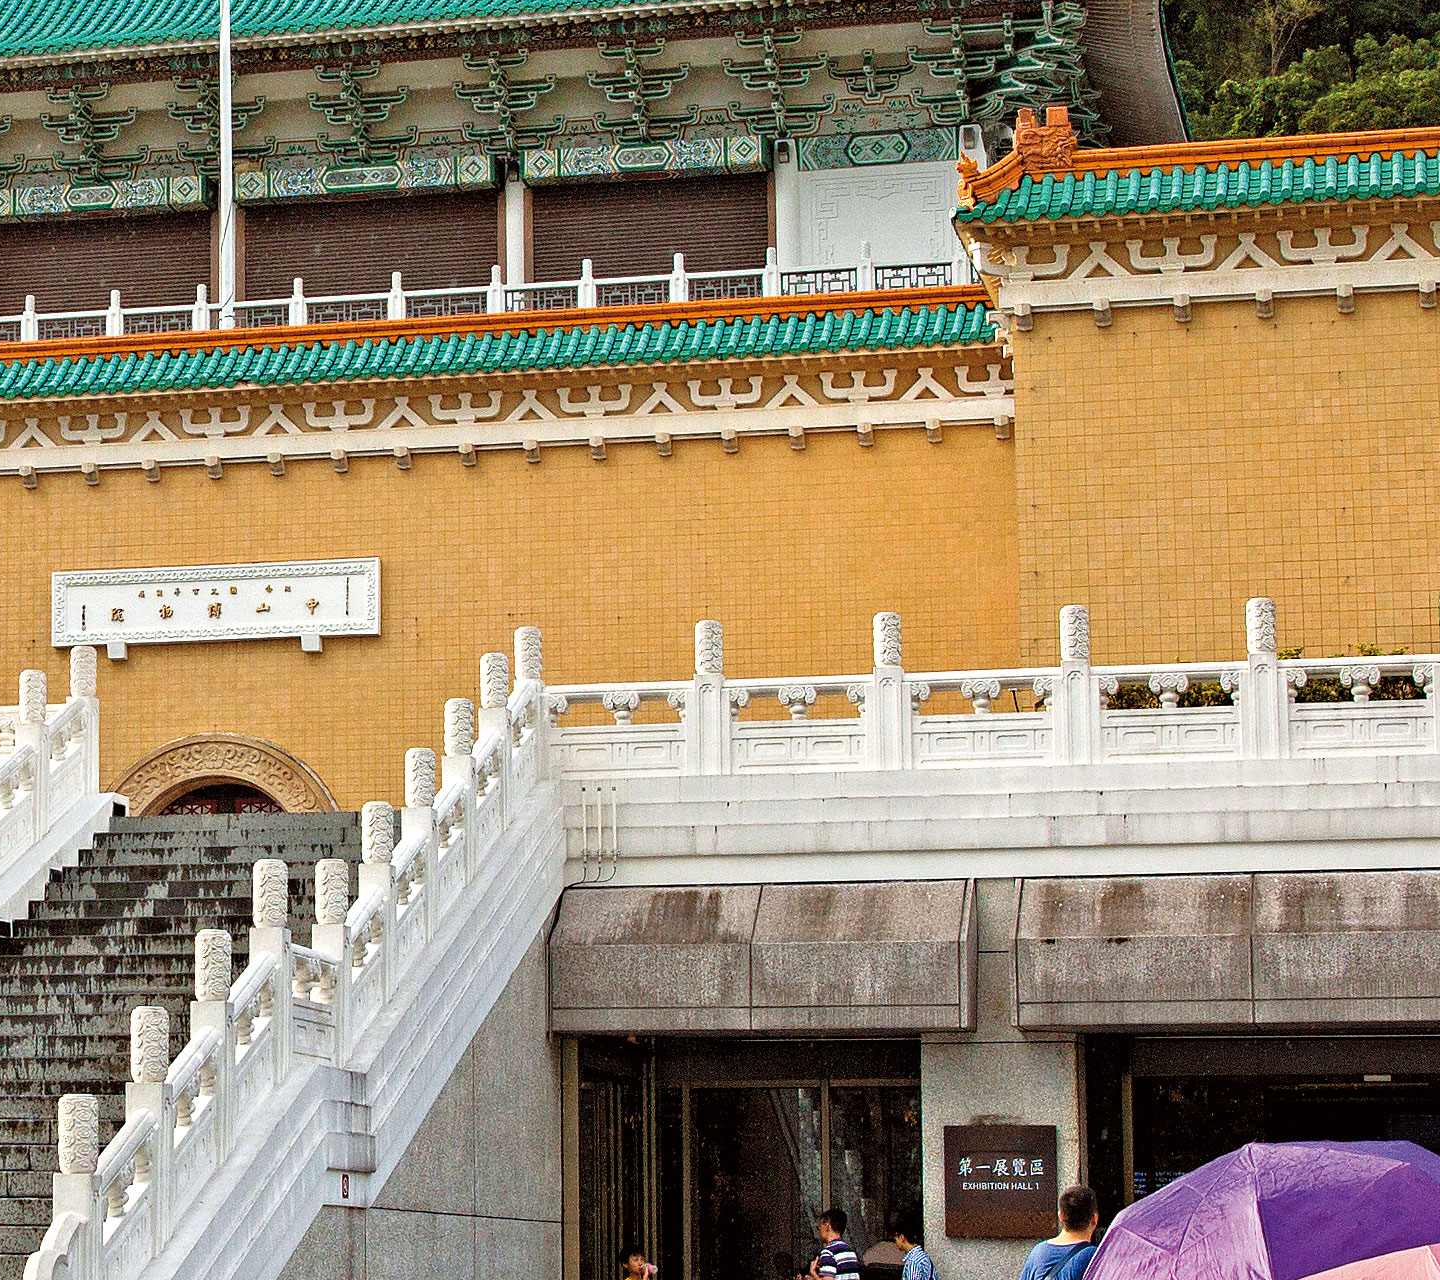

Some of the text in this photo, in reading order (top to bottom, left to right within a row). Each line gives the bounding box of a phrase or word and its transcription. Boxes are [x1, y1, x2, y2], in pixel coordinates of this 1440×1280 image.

[958, 1157, 1044, 1176] 第一展覽區
[962, 1182, 1039, 1190] EXHIBITION HALL 1
